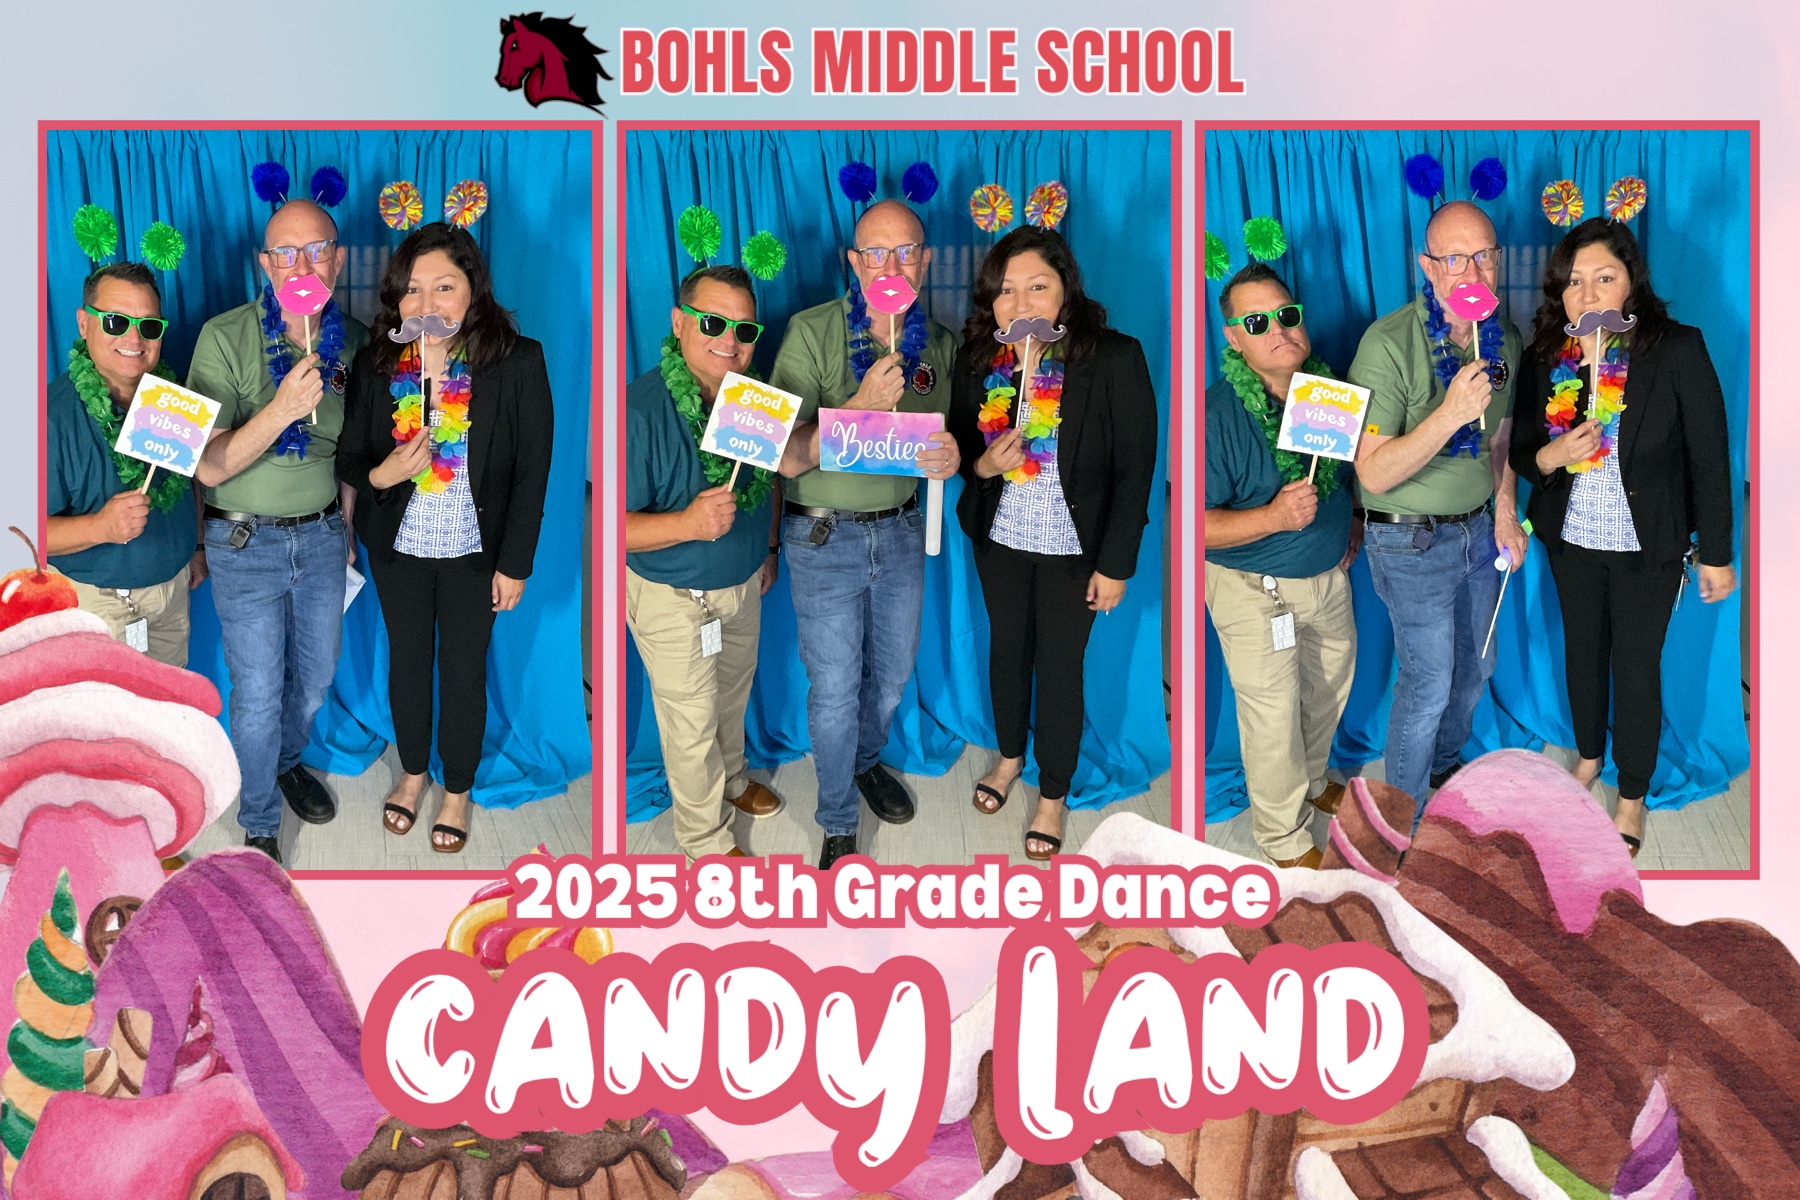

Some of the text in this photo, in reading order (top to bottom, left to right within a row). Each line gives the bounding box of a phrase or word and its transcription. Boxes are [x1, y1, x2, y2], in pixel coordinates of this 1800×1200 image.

[156, 392, 201, 415] good
[739, 389, 783, 411] good
[1309, 386, 1352, 404] good
[149, 413, 192, 439] vibes
[733, 411, 775, 435] vibes
[1305, 407, 1346, 427] vibes
[143, 439, 180, 463] only
[728, 436, 763, 459] only
[1303, 433, 1338, 452] only
